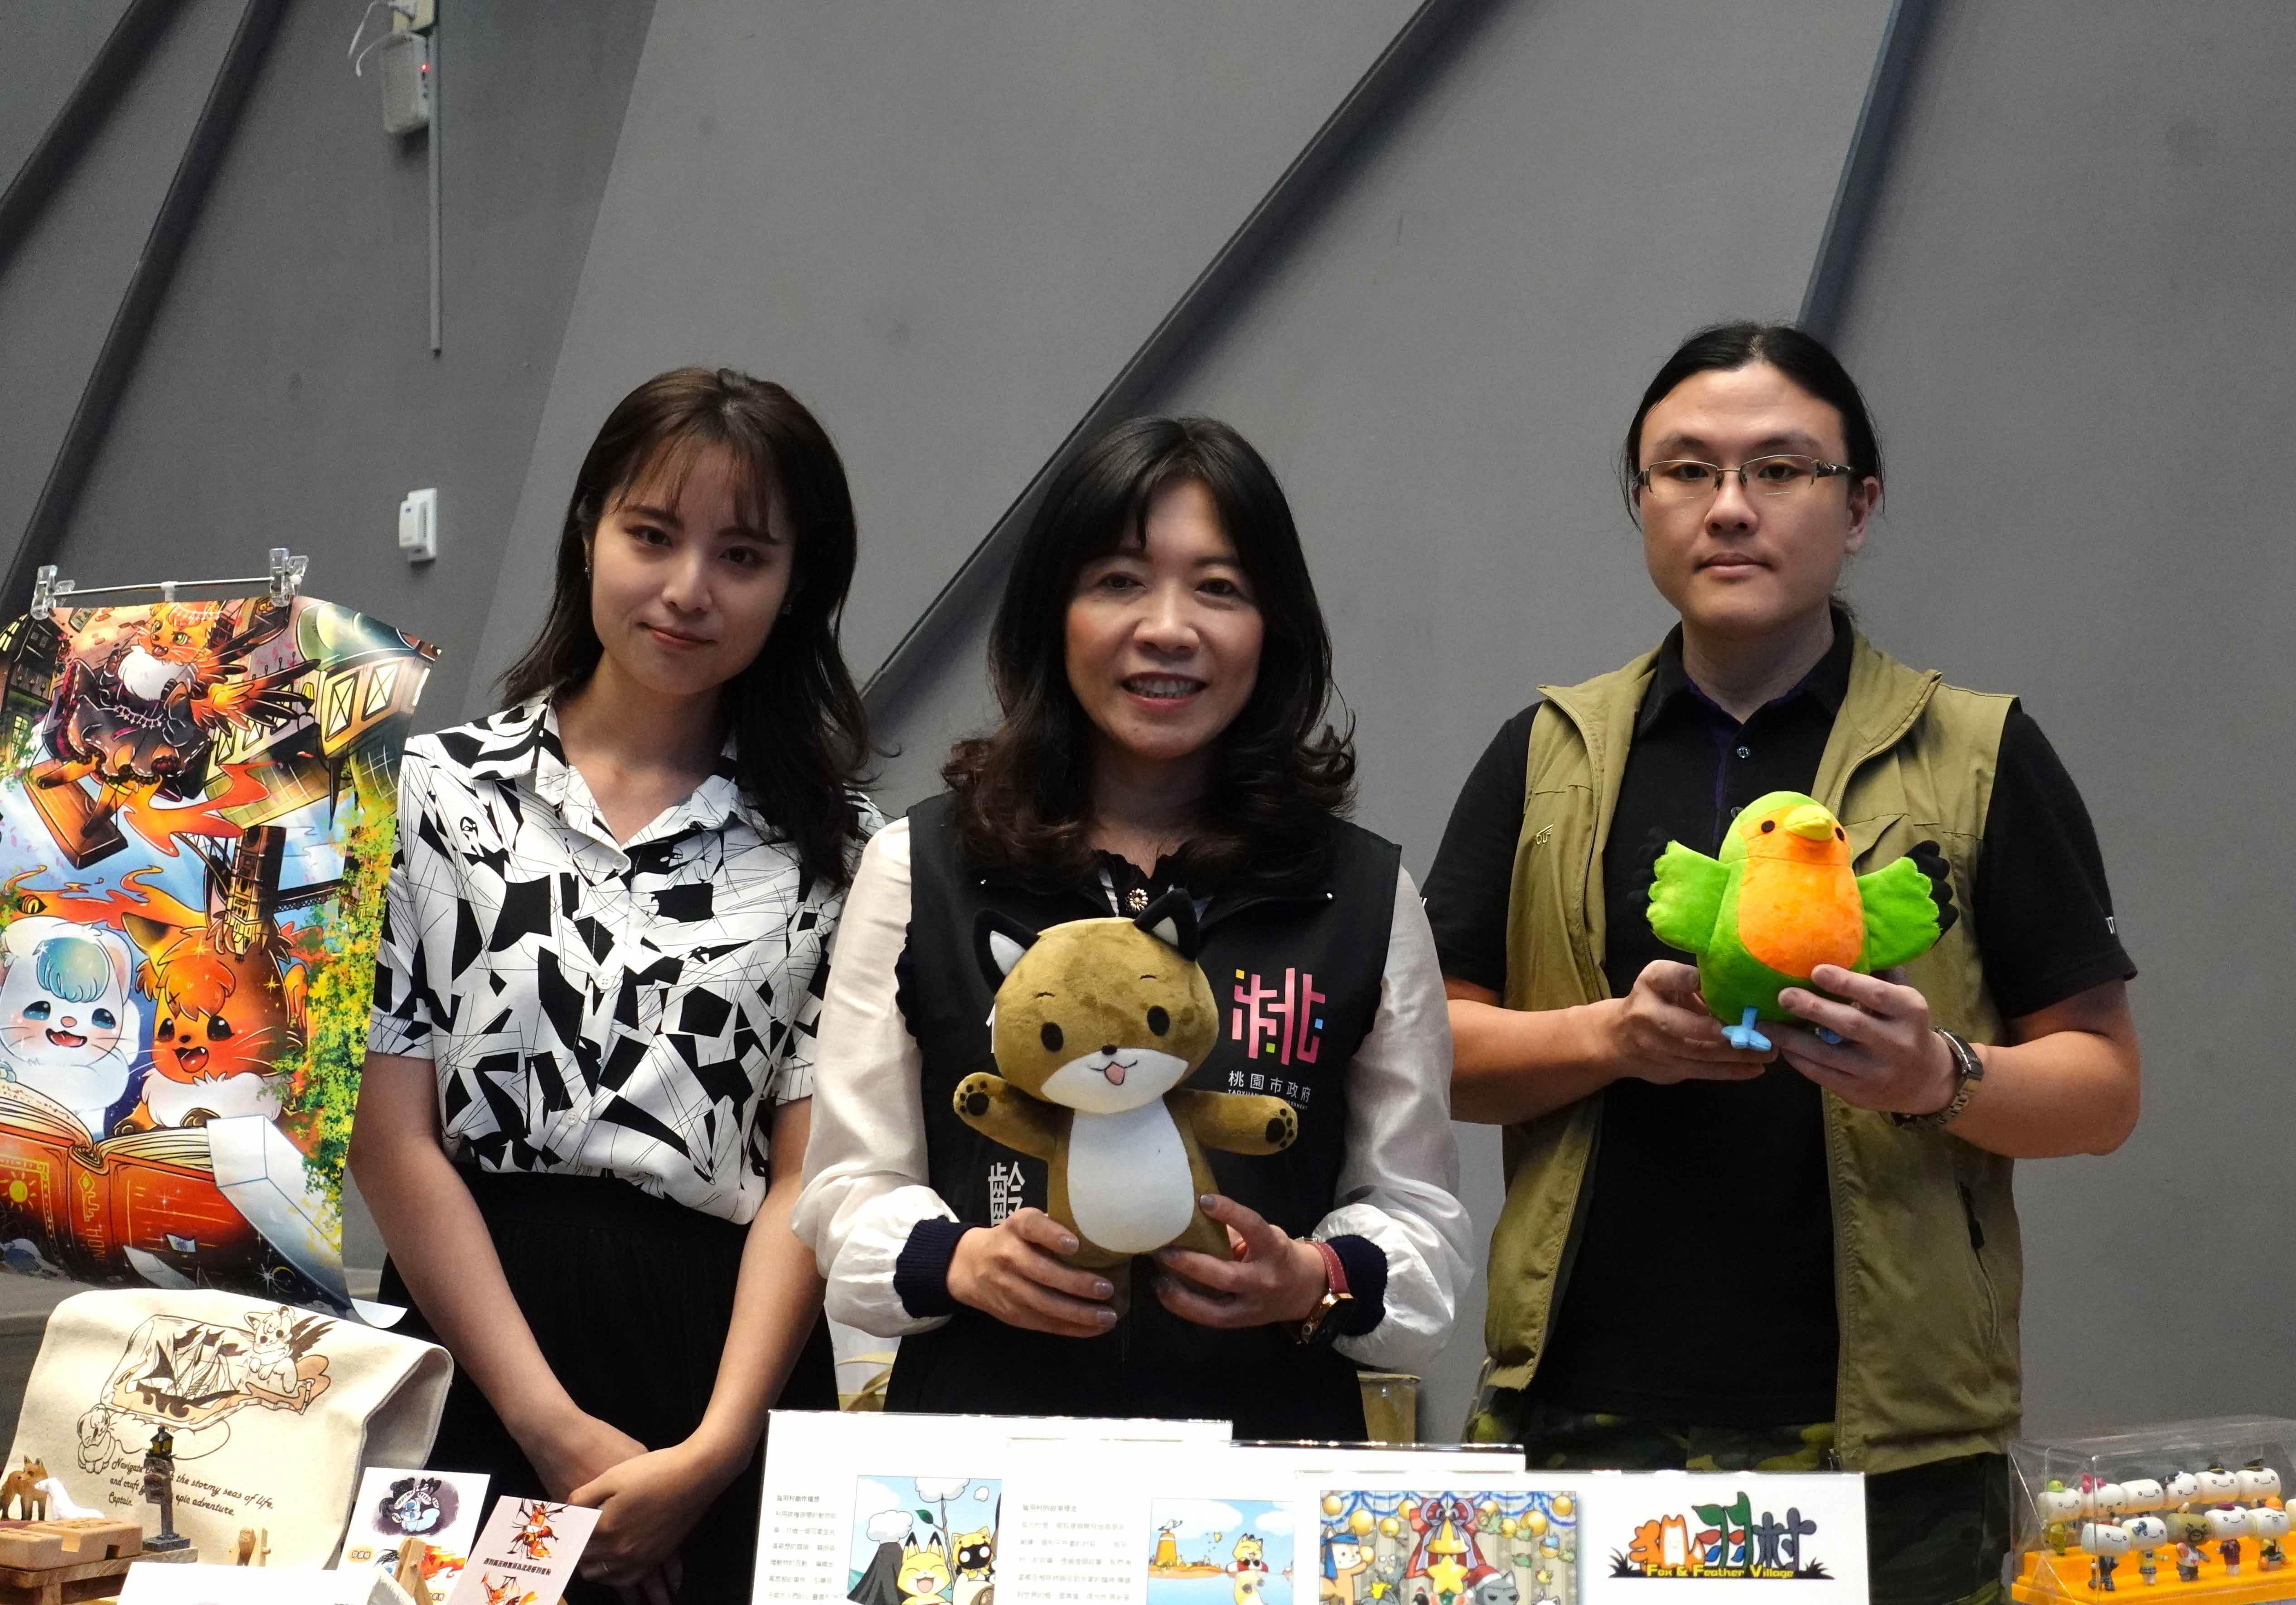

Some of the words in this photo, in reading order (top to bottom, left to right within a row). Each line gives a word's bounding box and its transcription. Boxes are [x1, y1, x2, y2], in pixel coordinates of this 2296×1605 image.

[1228, 1070, 1311, 1102] 桃園市政府
[110, 1476, 123, 1486] and
[123, 1479, 140, 1493] craft
[175, 1494, 190, 1506] epic
[176, 1473, 189, 1485] the
[191, 1479, 222, 1497] stormy
[223, 1488, 242, 1499] seas
[244, 1494, 259, 1506] of
[1647, 1564, 1672, 1577] Fox
[1676, 1566, 1689, 1577] &
[1693, 1564, 1745, 1577] Feather
[1749, 1565, 1794, 1578] Village
